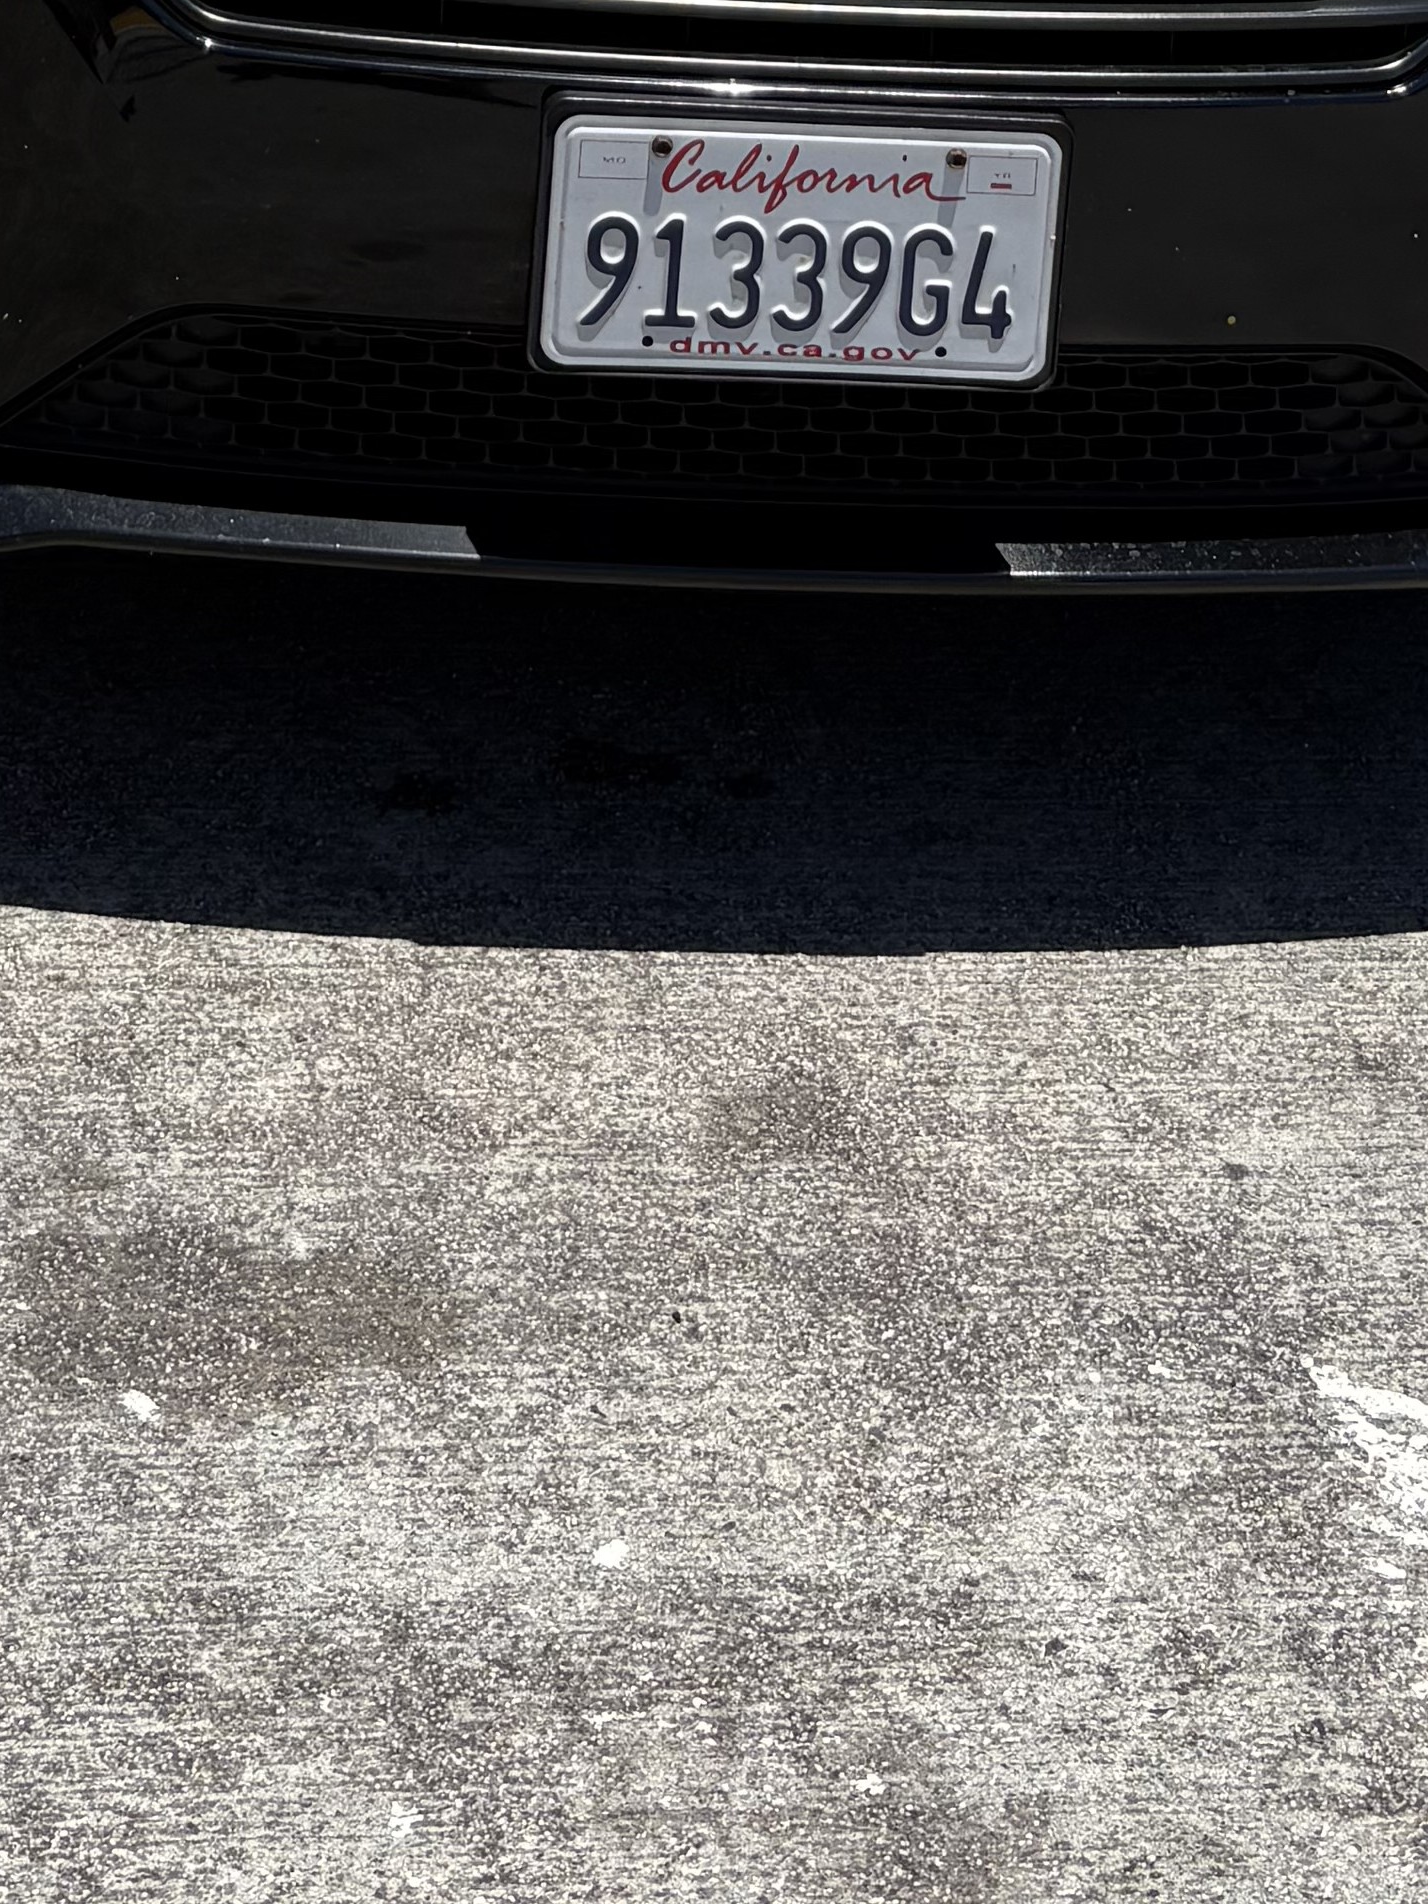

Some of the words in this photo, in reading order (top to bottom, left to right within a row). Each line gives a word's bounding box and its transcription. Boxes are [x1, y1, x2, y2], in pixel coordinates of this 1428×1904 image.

[661, 138, 966, 214] California
[577, 215, 1013, 341] 91339G4
[669, 336, 921, 362] dmv.ca.gov
